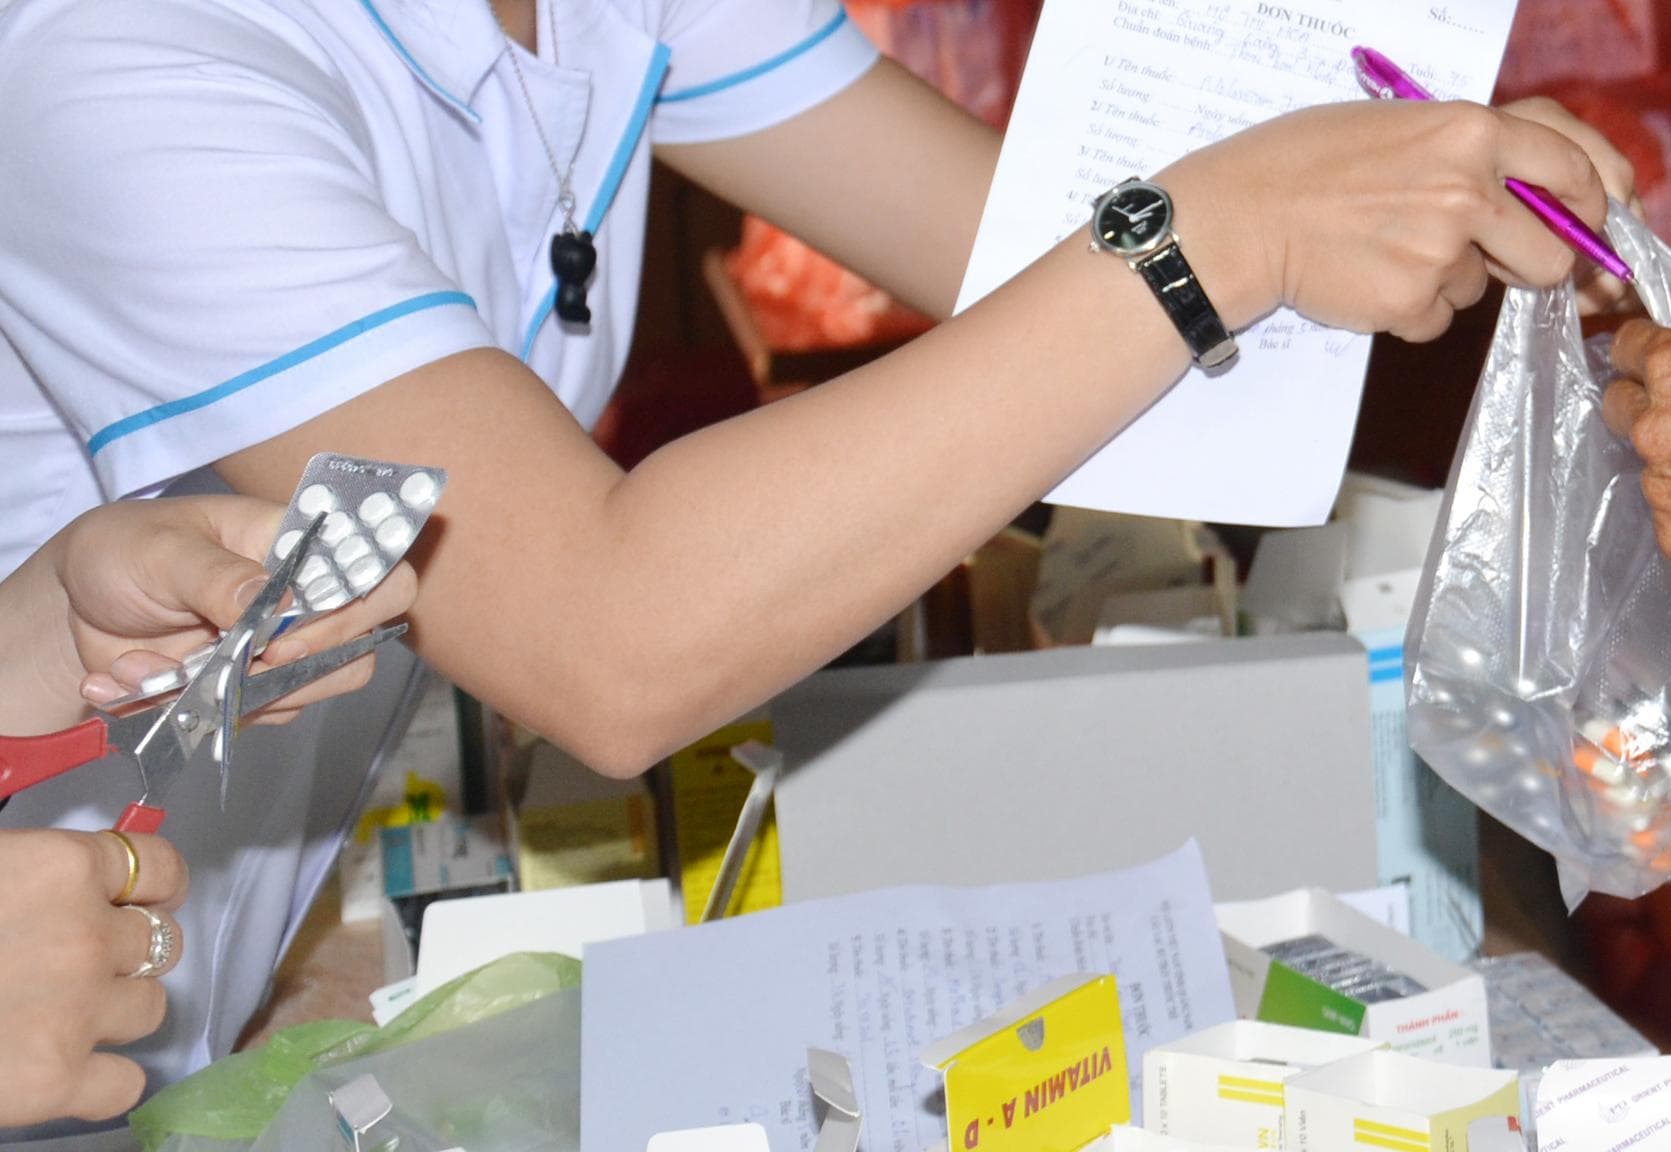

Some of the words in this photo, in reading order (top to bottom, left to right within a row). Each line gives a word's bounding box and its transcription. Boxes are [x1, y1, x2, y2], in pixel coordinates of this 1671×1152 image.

[1255, 1, 1293, 23] ĐƠN
[1297, 11, 1354, 39] THUỐC
[1024, 1045, 1113, 1117] VITAMIN
[1557, 1064, 1630, 1104] PHARMACEUTICAL
[1631, 1083, 1662, 1103] ORIENT
[1002, 1098, 1018, 1129] A
[964, 1118, 980, 1150] D
